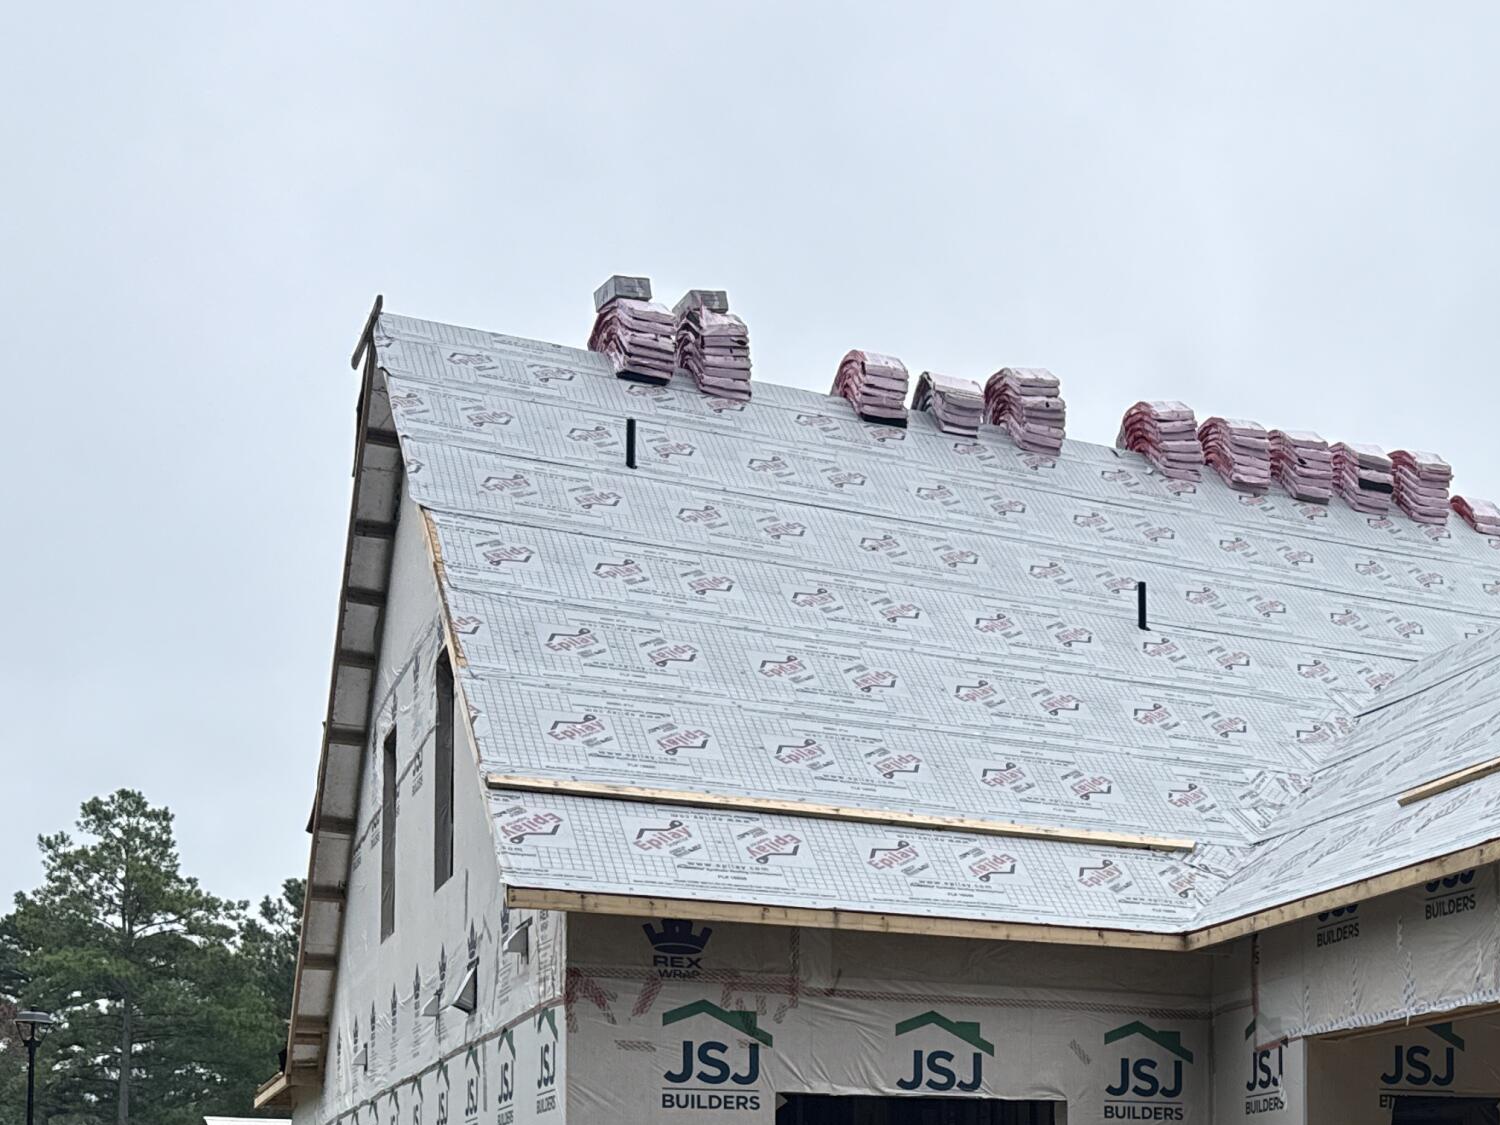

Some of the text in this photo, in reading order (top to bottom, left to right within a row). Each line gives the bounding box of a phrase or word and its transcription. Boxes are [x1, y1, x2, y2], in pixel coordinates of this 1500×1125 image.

[548, 719, 605, 741] Epilay
[657, 729, 711, 751] Epilay
[500, 812, 564, 839] Epilay
[633, 826, 692, 851] Epilay
[746, 834, 802, 859] Epilay
[867, 846, 919, 870] Epilay
[969, 853, 1017, 877] Epilay
[1425, 894, 1476, 920] BUILDERS
[1316, 922, 1360, 947] BUILDERS
[653, 955, 702, 969] REX
[537, 1041, 555, 1089] JSJ
[664, 1041, 759, 1085] JSJ
[896, 1050, 982, 1091] JSJ
[1246, 1048, 1283, 1090] JSJ
[1381, 1045, 1454, 1086] JSJ
[1105, 1058, 1183, 1097] JSJ
[662, 1094, 760, 1111] BUILDERS
[1104, 1105, 1183, 1121] BUILDERS
[1245, 1097, 1285, 1115] BUILDERS
